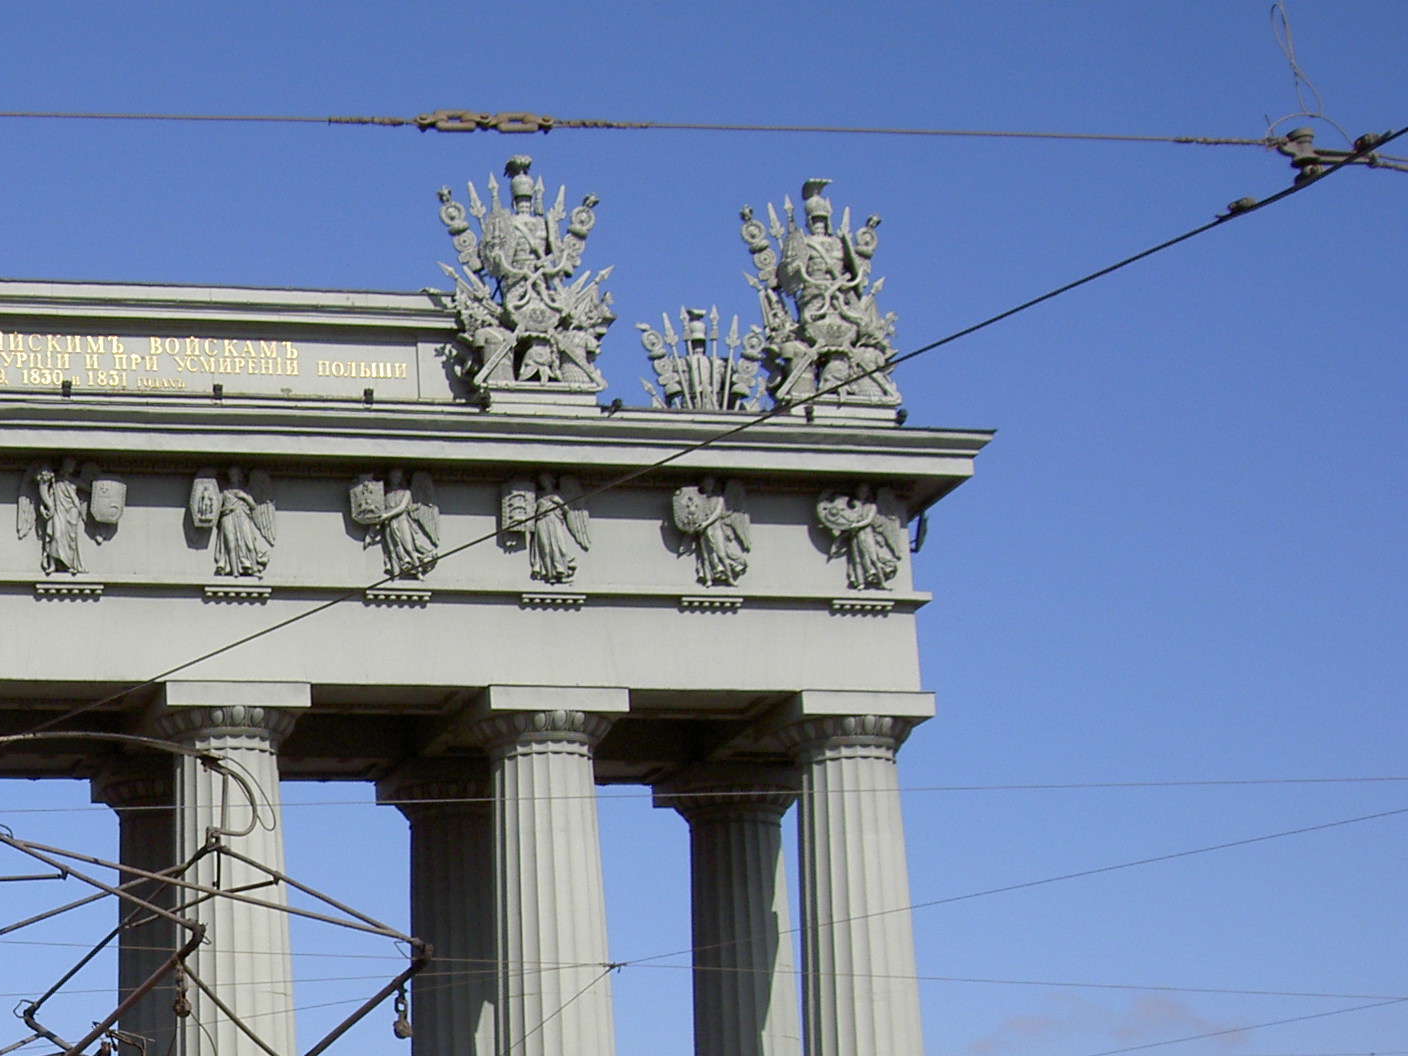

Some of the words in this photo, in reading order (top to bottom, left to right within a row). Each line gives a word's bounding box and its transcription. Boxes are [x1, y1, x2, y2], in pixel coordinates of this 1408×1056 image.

[149, 336, 299, 360] ВОЙСКАМЪ
[22, 369, 64, 385] 1830
[87, 370, 127, 387] 1831
[84, 354, 99, 369] И
[114, 354, 159, 371] ПРИ
[317, 360, 408, 379] ПОЛЬШИ
